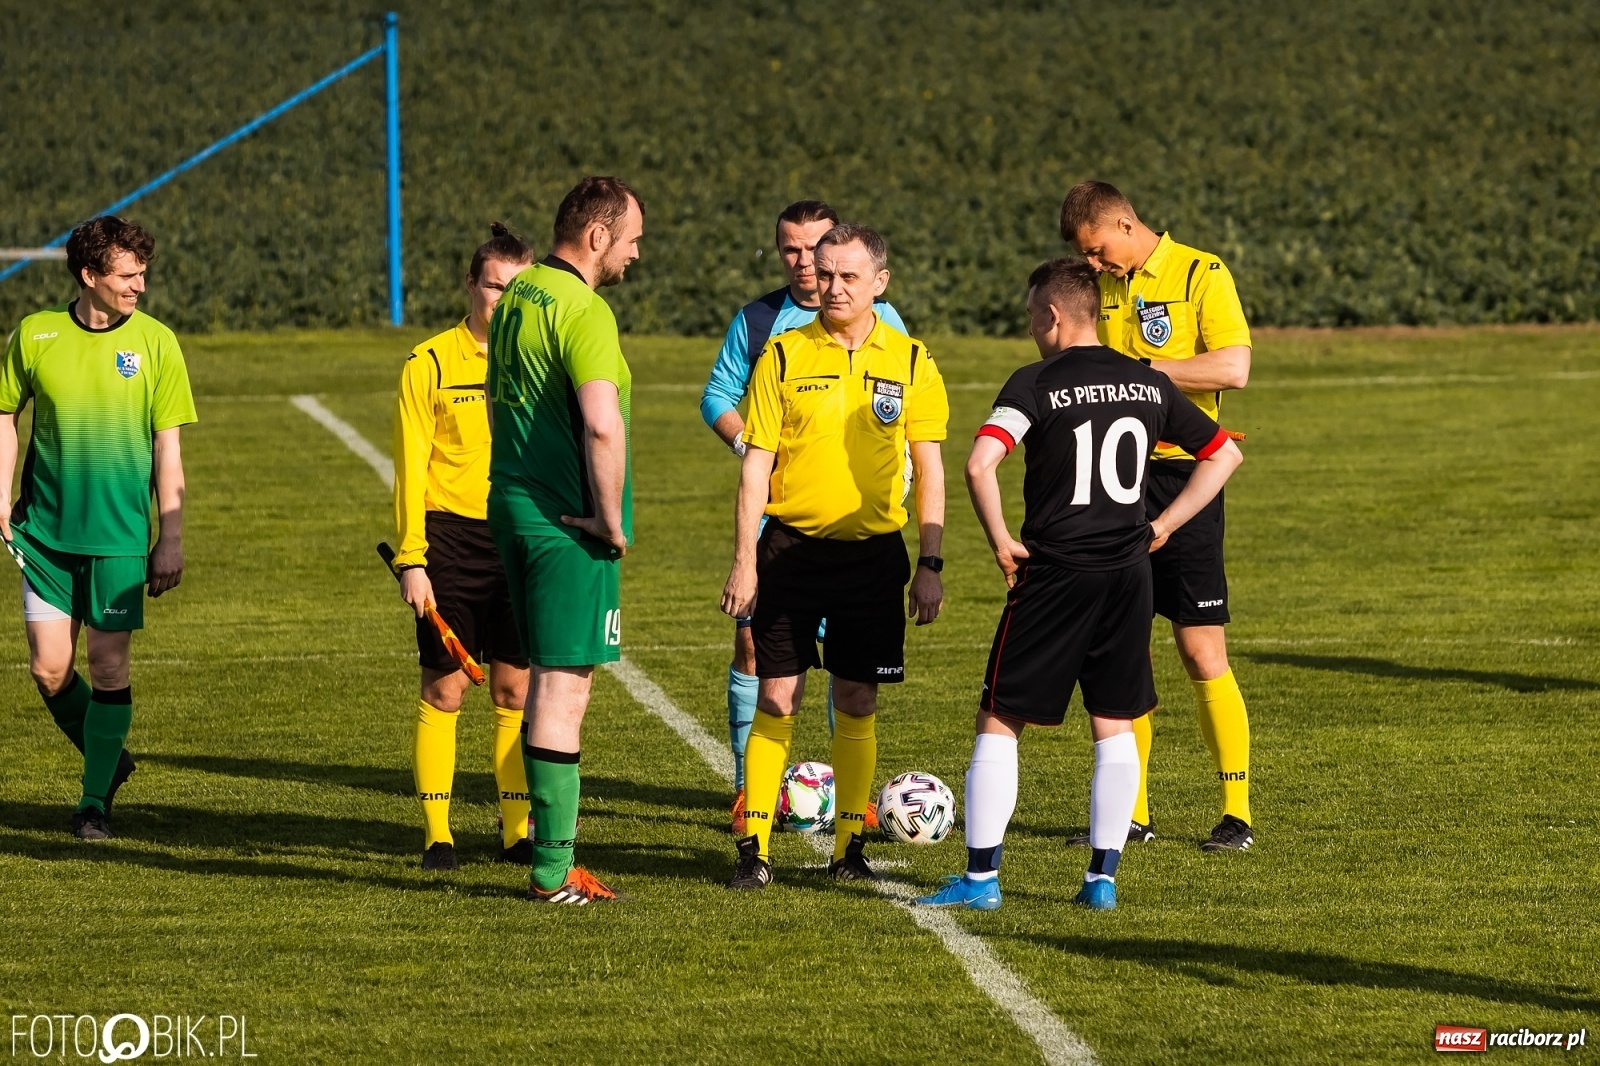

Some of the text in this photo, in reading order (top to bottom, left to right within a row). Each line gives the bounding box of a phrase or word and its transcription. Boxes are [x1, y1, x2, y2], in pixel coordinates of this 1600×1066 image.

[515, 280, 556, 307] GAMÓW
[1048, 383, 1162, 409] KS PIETRASZYN
[1070, 416, 1149, 506] 10
[604, 609, 621, 645] 19
